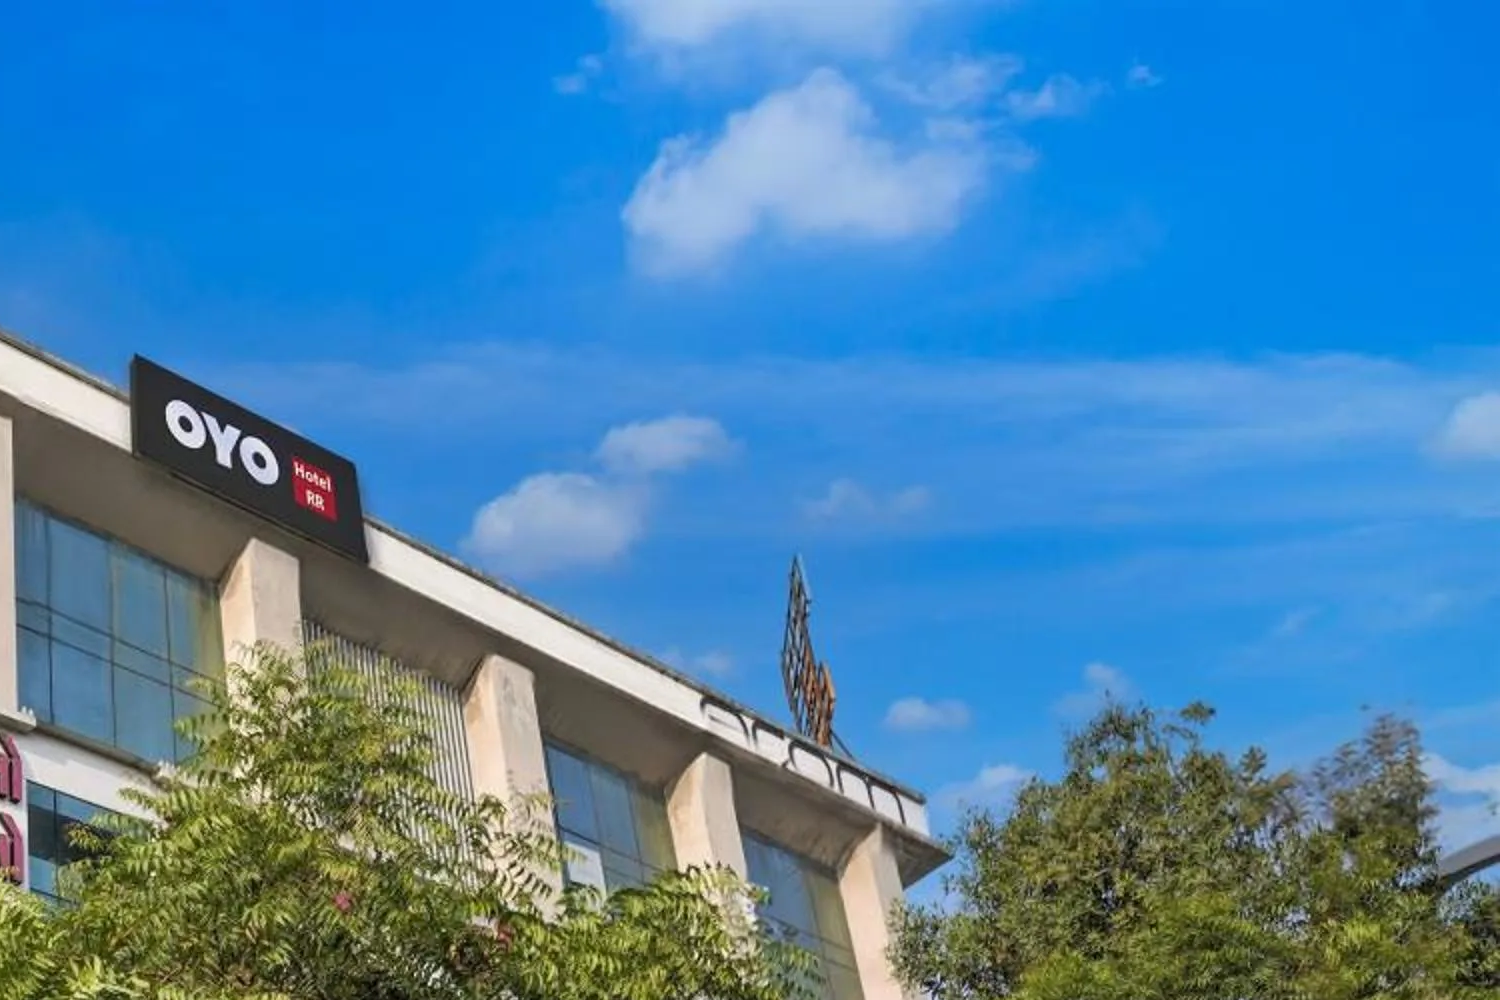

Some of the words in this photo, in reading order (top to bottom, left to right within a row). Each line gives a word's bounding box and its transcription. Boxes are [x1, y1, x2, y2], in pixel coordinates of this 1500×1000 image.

[165, 400, 279, 485] OYO
[295, 461, 332, 492] Hotel
[306, 490, 325, 511] RR
